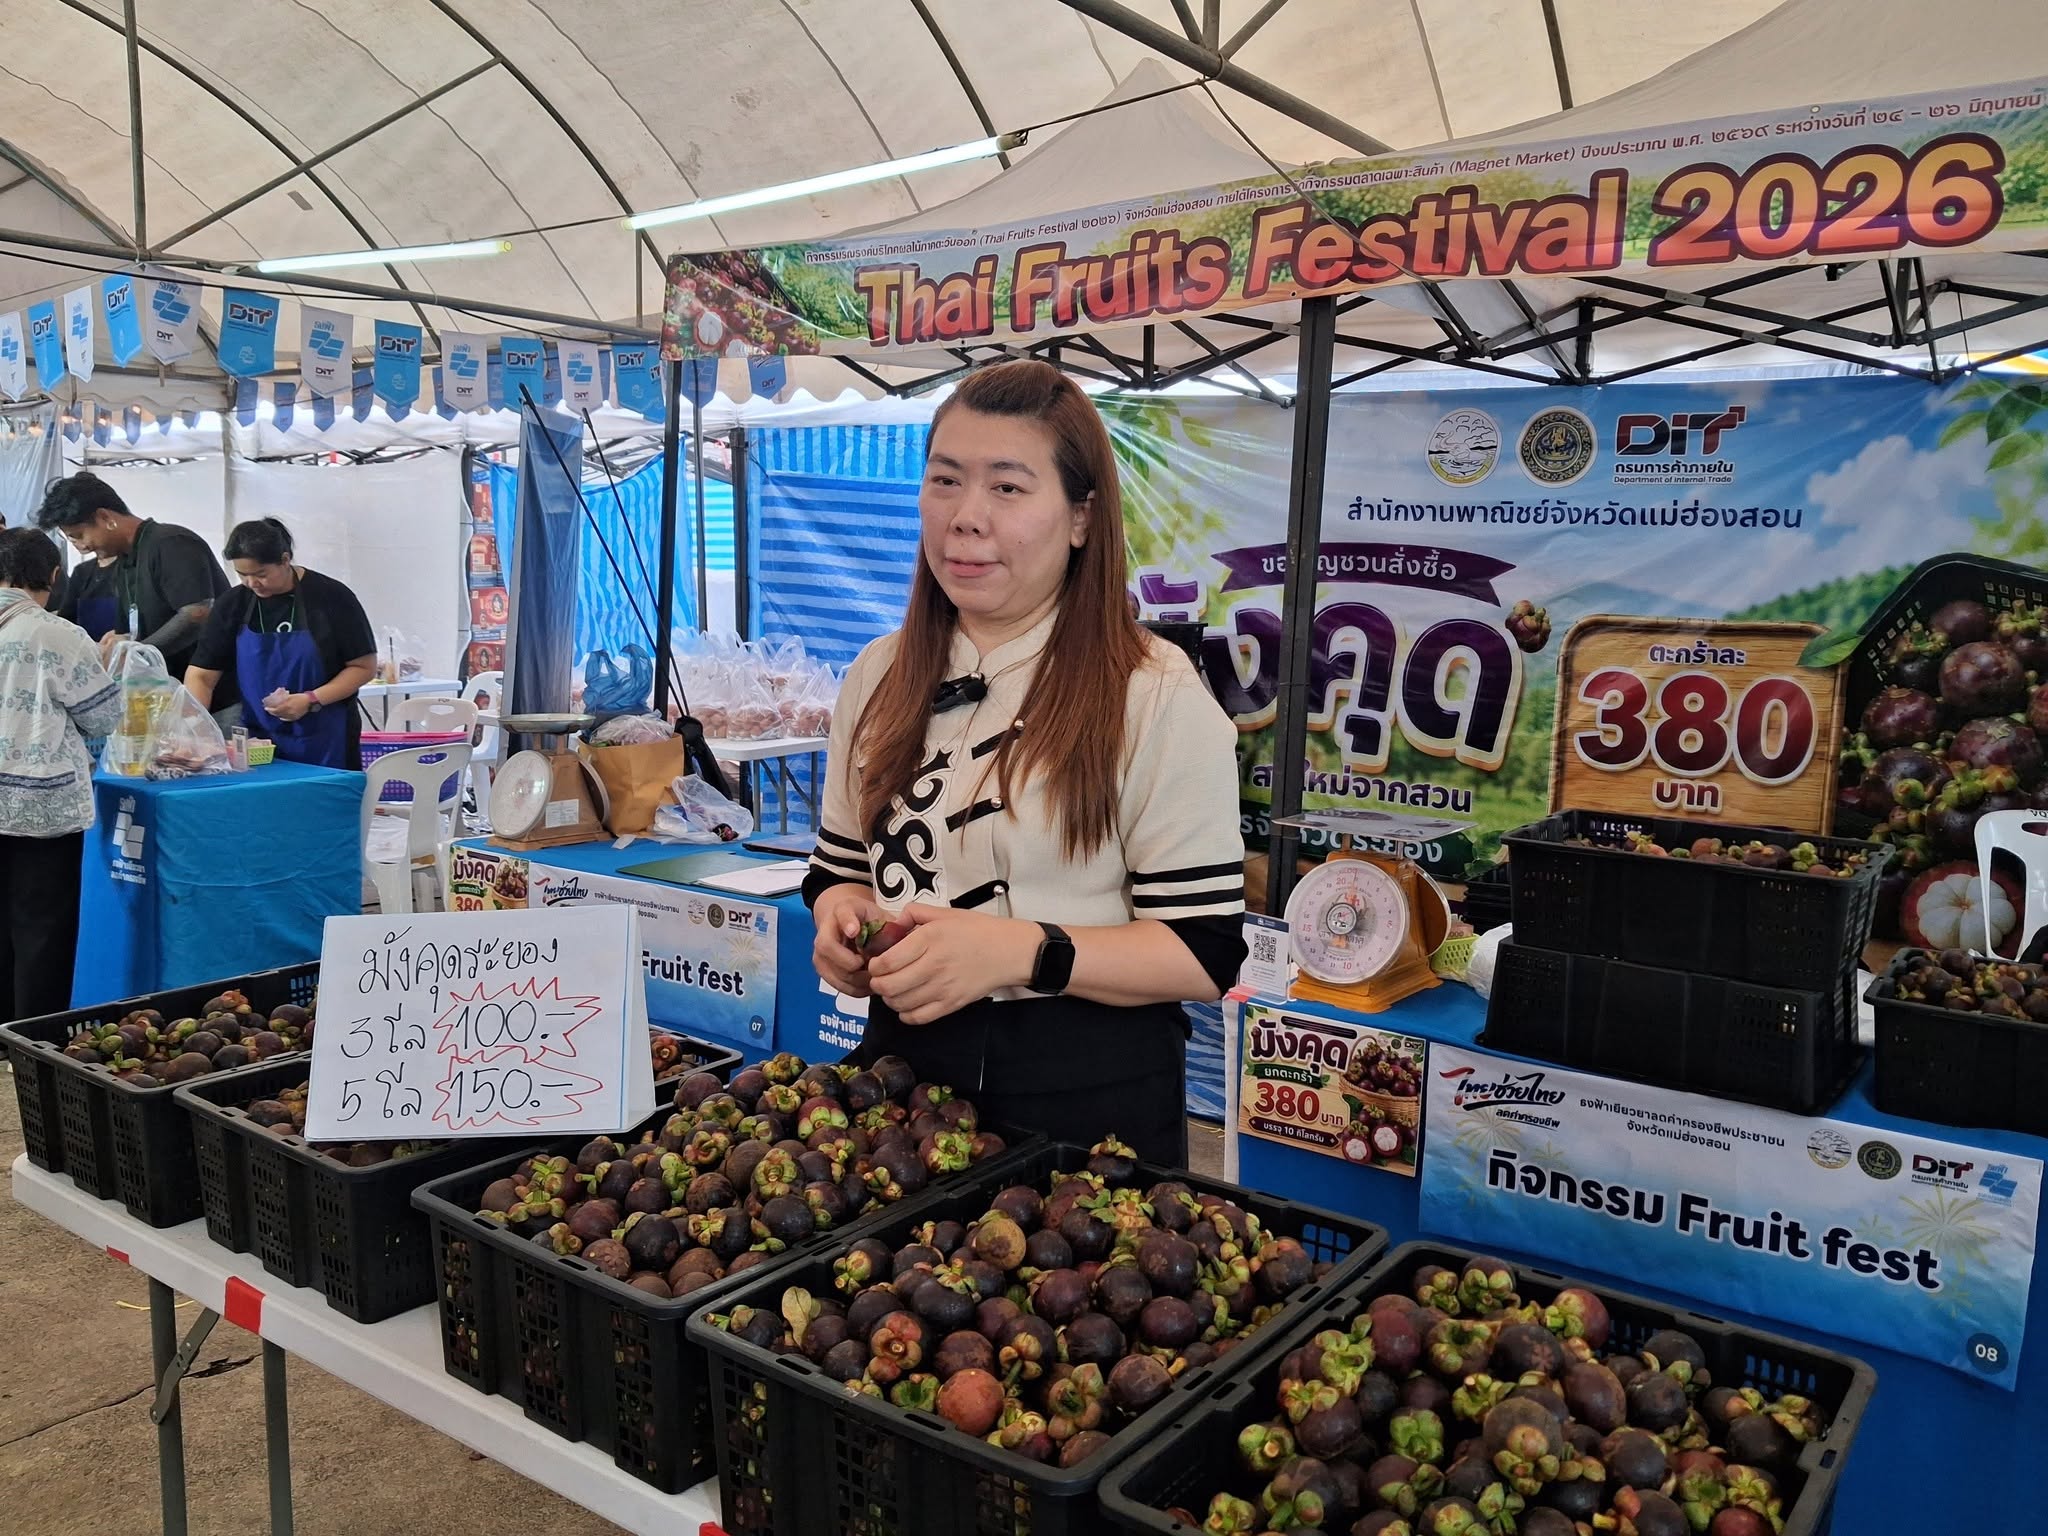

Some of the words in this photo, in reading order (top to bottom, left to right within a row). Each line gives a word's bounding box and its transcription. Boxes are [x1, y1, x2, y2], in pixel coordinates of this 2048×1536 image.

[979, 233, 1005, 248] (Thai
[1007, 227, 1035, 242] Fruits
[1038, 219, 1078, 236] Festival
[1081, 207, 1121, 229] ๒๐๒๖)
[1124, 196, 1213, 222] จังหวัดแม่ฮ่องสอน
[1449, 156, 1511, 175] (Magnet
[1515, 147, 1576, 166] Market)
[1580, 138, 1667, 160] ปีงบประมาณ
[1672, 132, 1704, 148] พ.ศ.
[1775, 106, 1867, 136] ระหว่างวันที่
[1968, 94, 2041, 116] มิถุนายน
[855, 254, 998, 347] Thai
[1010, 228, 1231, 333] Fruits
[1243, 167, 1626, 298] Festival
[1649, 133, 2005, 267] 2026
[1614, 475, 1663, 485] Department
[1664, 475, 1673, 484] of
[1674, 475, 1706, 484] Internal
[1708, 475, 1732, 484] Trade
[1615, 459, 1734, 474] กรมการค้าภายใน
[1346, 497, 1804, 529] สำนักงานพาณิชย์จังหวัดแม่ฮ่องสอน
[1138, 569, 1518, 766] ังคุด
[1649, 640, 1747, 666] ตะกร้าละ
[1576, 667, 1817, 785] 380
[1653, 779, 1723, 814] บาท
[453, 854, 496, 888] มังคุด
[455, 896, 484, 911] 380
[358, 926, 558, 1014] มังคุดระยอง
[698, 961, 745, 996] fest
[340, 1017, 374, 1058] 3
[384, 1003, 426, 1053] โล
[751, 1022, 762, 1032] 07
[819, 1030, 862, 1051] ลดค่าคร
[1251, 1019, 1349, 1075] มังคุด
[337, 1078, 366, 1122] 5
[375, 1062, 422, 1119] โล
[1264, 1066, 1313, 1084] ยกตะกร้า
[1439, 1066, 1566, 1106] ไทยช่วยไทย
[1255, 1082, 1320, 1121] 380
[1321, 1113, 1344, 1126] บาท
[1263, 1122, 1282, 1136] บรรจุ
[1285, 1126, 1294, 1135] 10
[1296, 1128, 1325, 1143] กิโลกรัม
[1580, 1098, 1785, 1147] ธงฟ้าเยียวยาลดค่าครองชีพประชาชน
[1627, 1120, 1731, 1151] จังหวัดแม่ฮ่องสอน
[1488, 1147, 1664, 1225] กิจกรรม
[1678, 1193, 1812, 1258] Fruit
[1822, 1228, 1939, 1290] fest
[1975, 1343, 1997, 1361] 08
